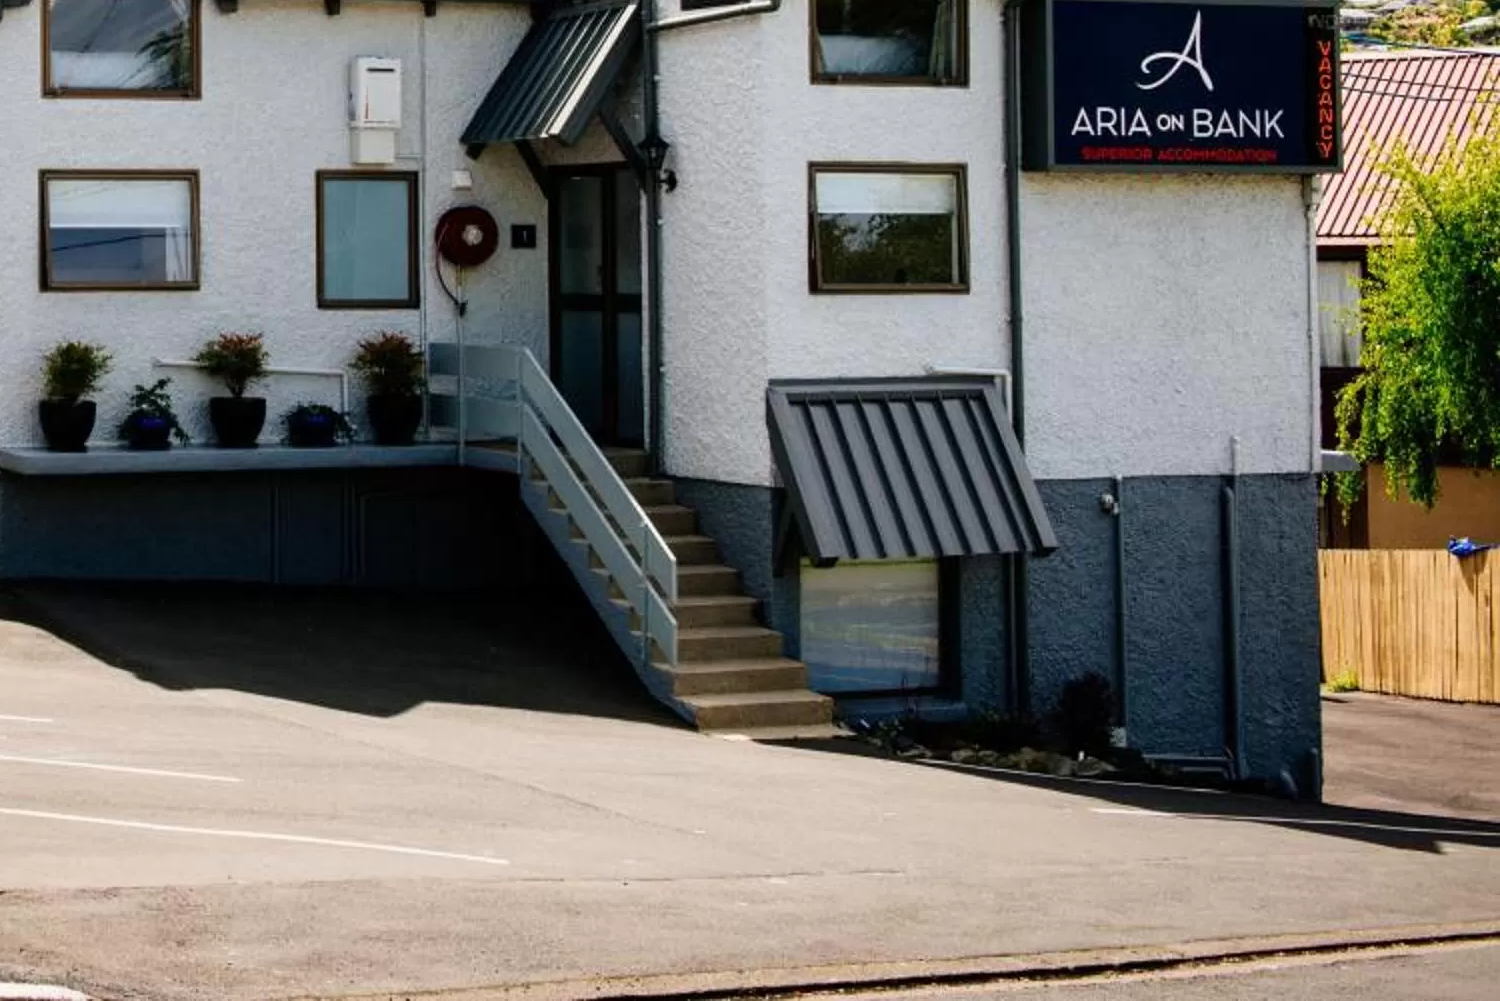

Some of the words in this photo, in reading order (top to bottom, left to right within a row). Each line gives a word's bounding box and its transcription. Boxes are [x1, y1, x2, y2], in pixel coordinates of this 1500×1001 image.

[1316, 40, 1334, 160] VACANCY
[1071, 106, 1152, 137] ARIA
[1156, 113, 1184, 132] ON
[1193, 108, 1285, 139] BANK
[1081, 146, 1152, 161] SUPERIOR
[1157, 148, 1277, 163] ACCOMMODATION
